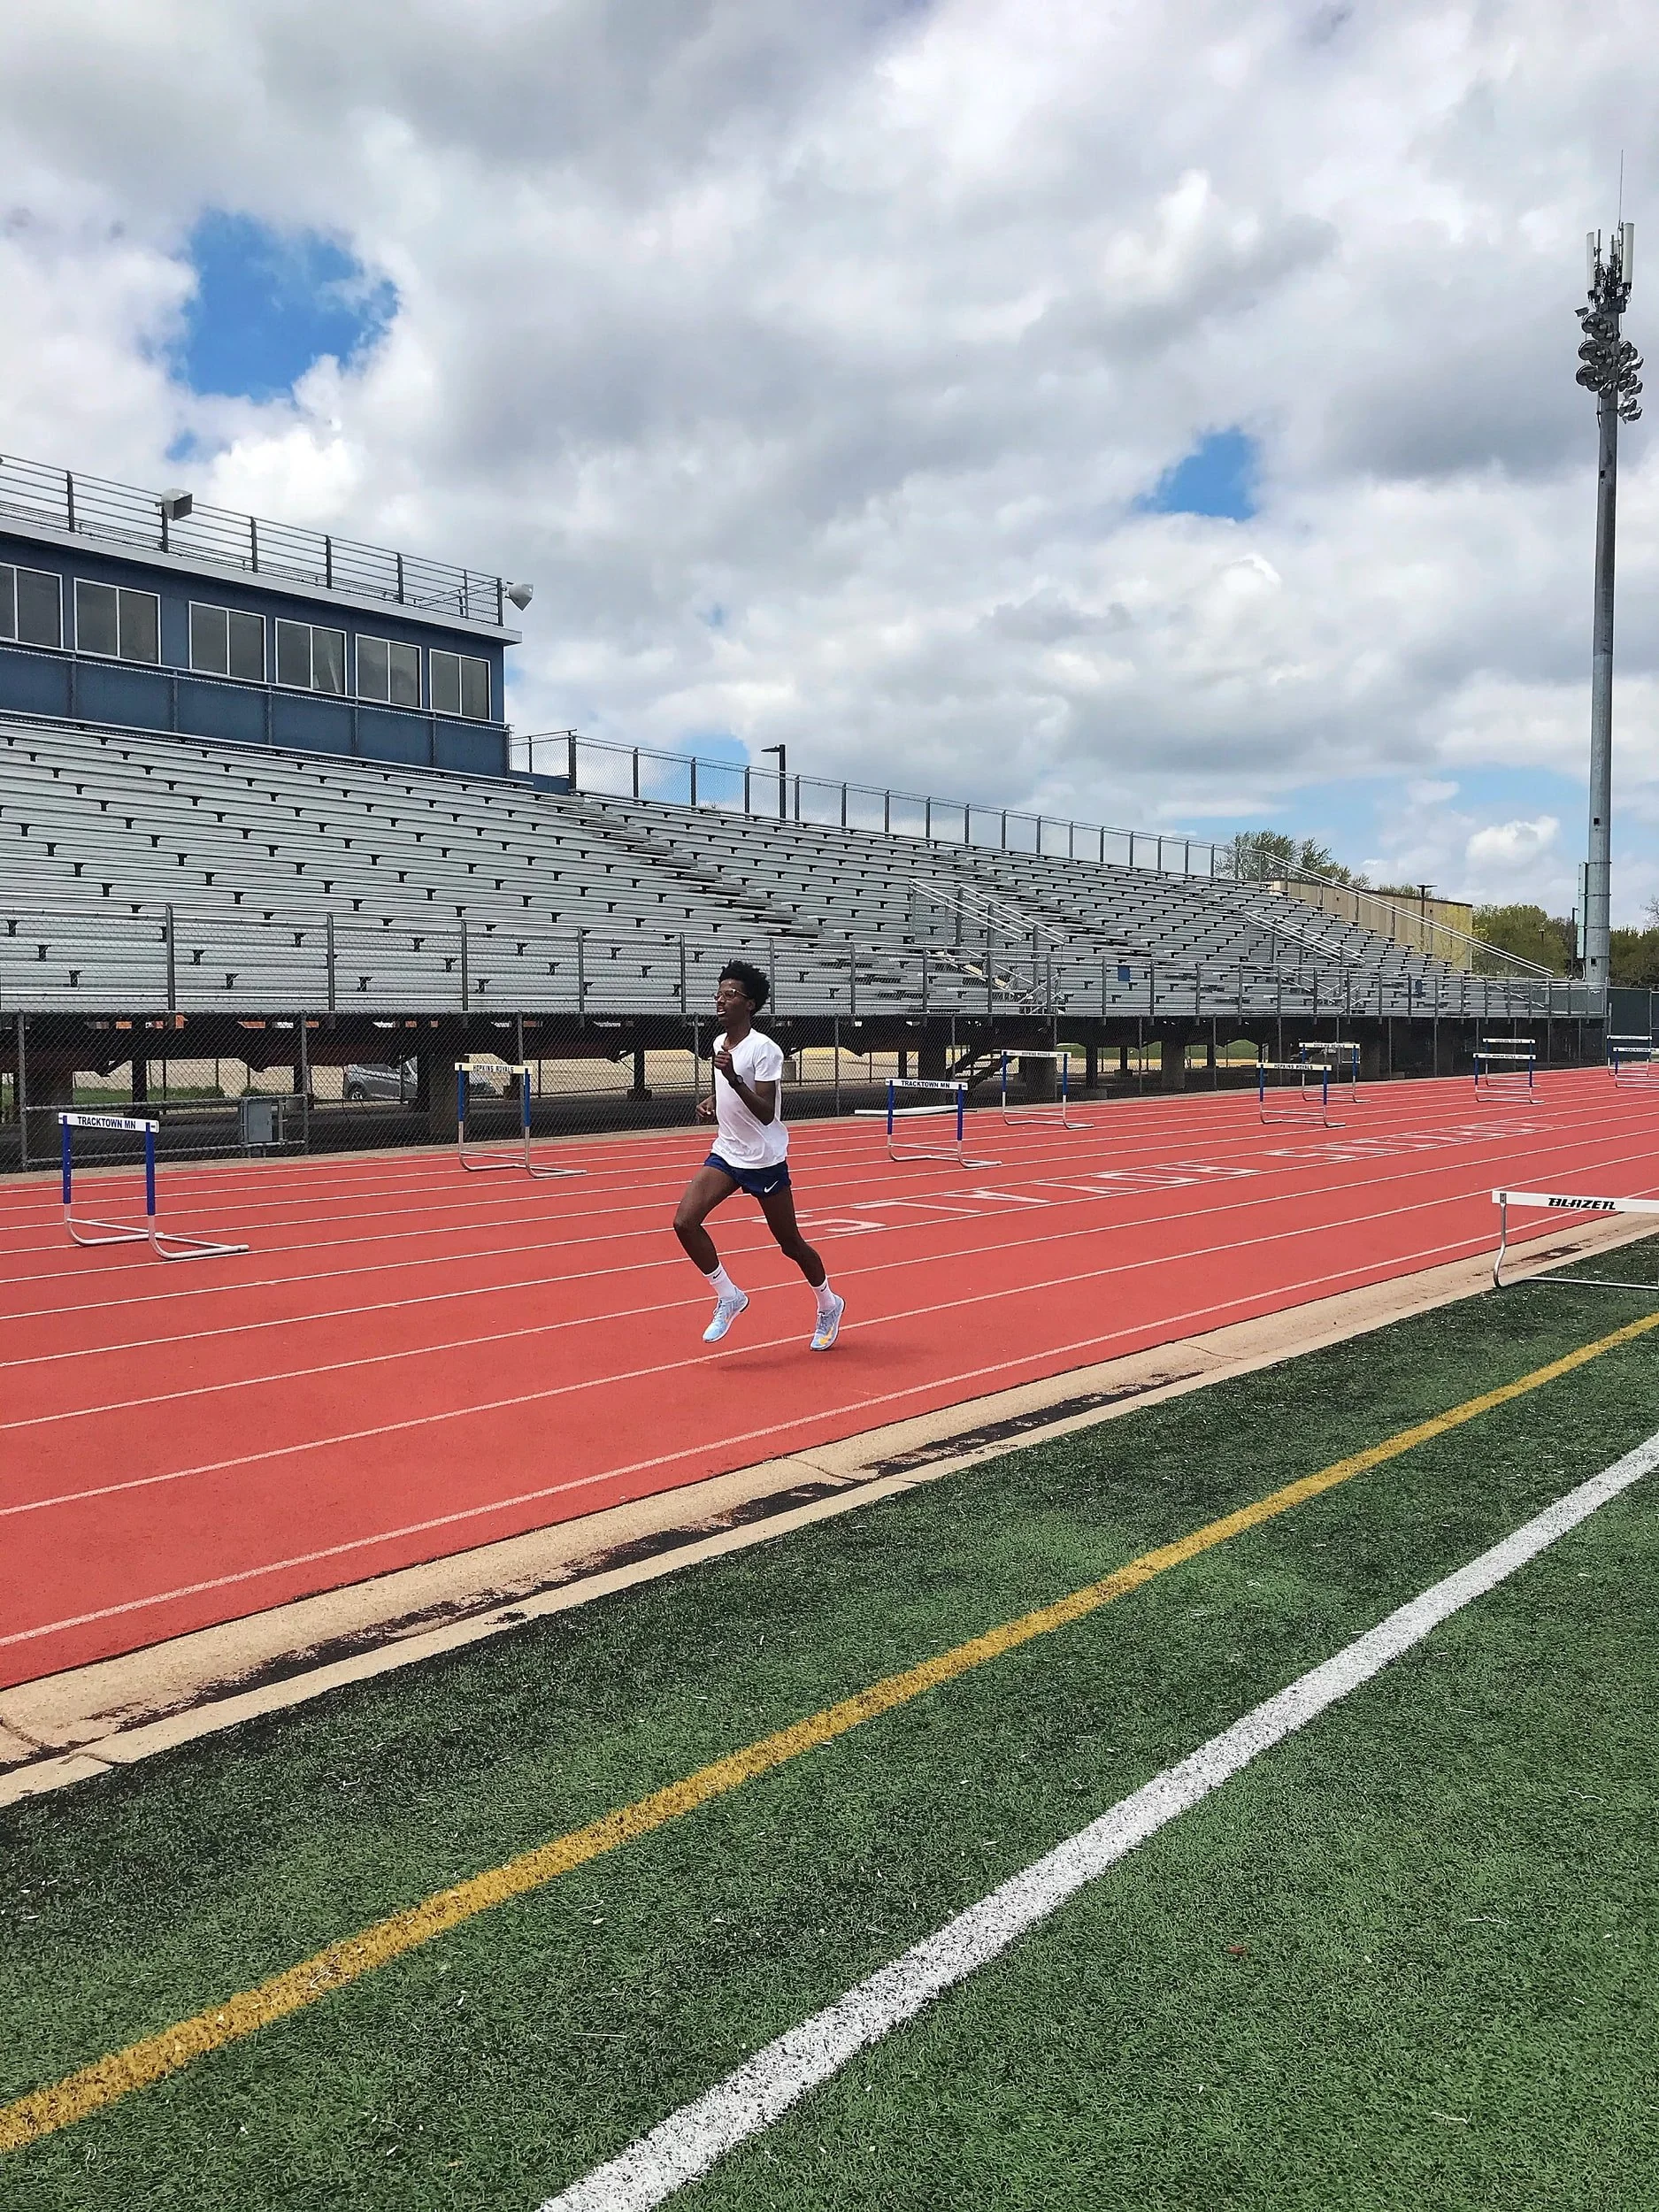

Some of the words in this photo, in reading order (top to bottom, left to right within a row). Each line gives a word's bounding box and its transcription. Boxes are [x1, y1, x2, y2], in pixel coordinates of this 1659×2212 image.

[78, 1116, 122, 1129] TRACKTOWN
[125, 1120, 136, 1130] MN
[1548, 1197, 1617, 1210] BLAZER
